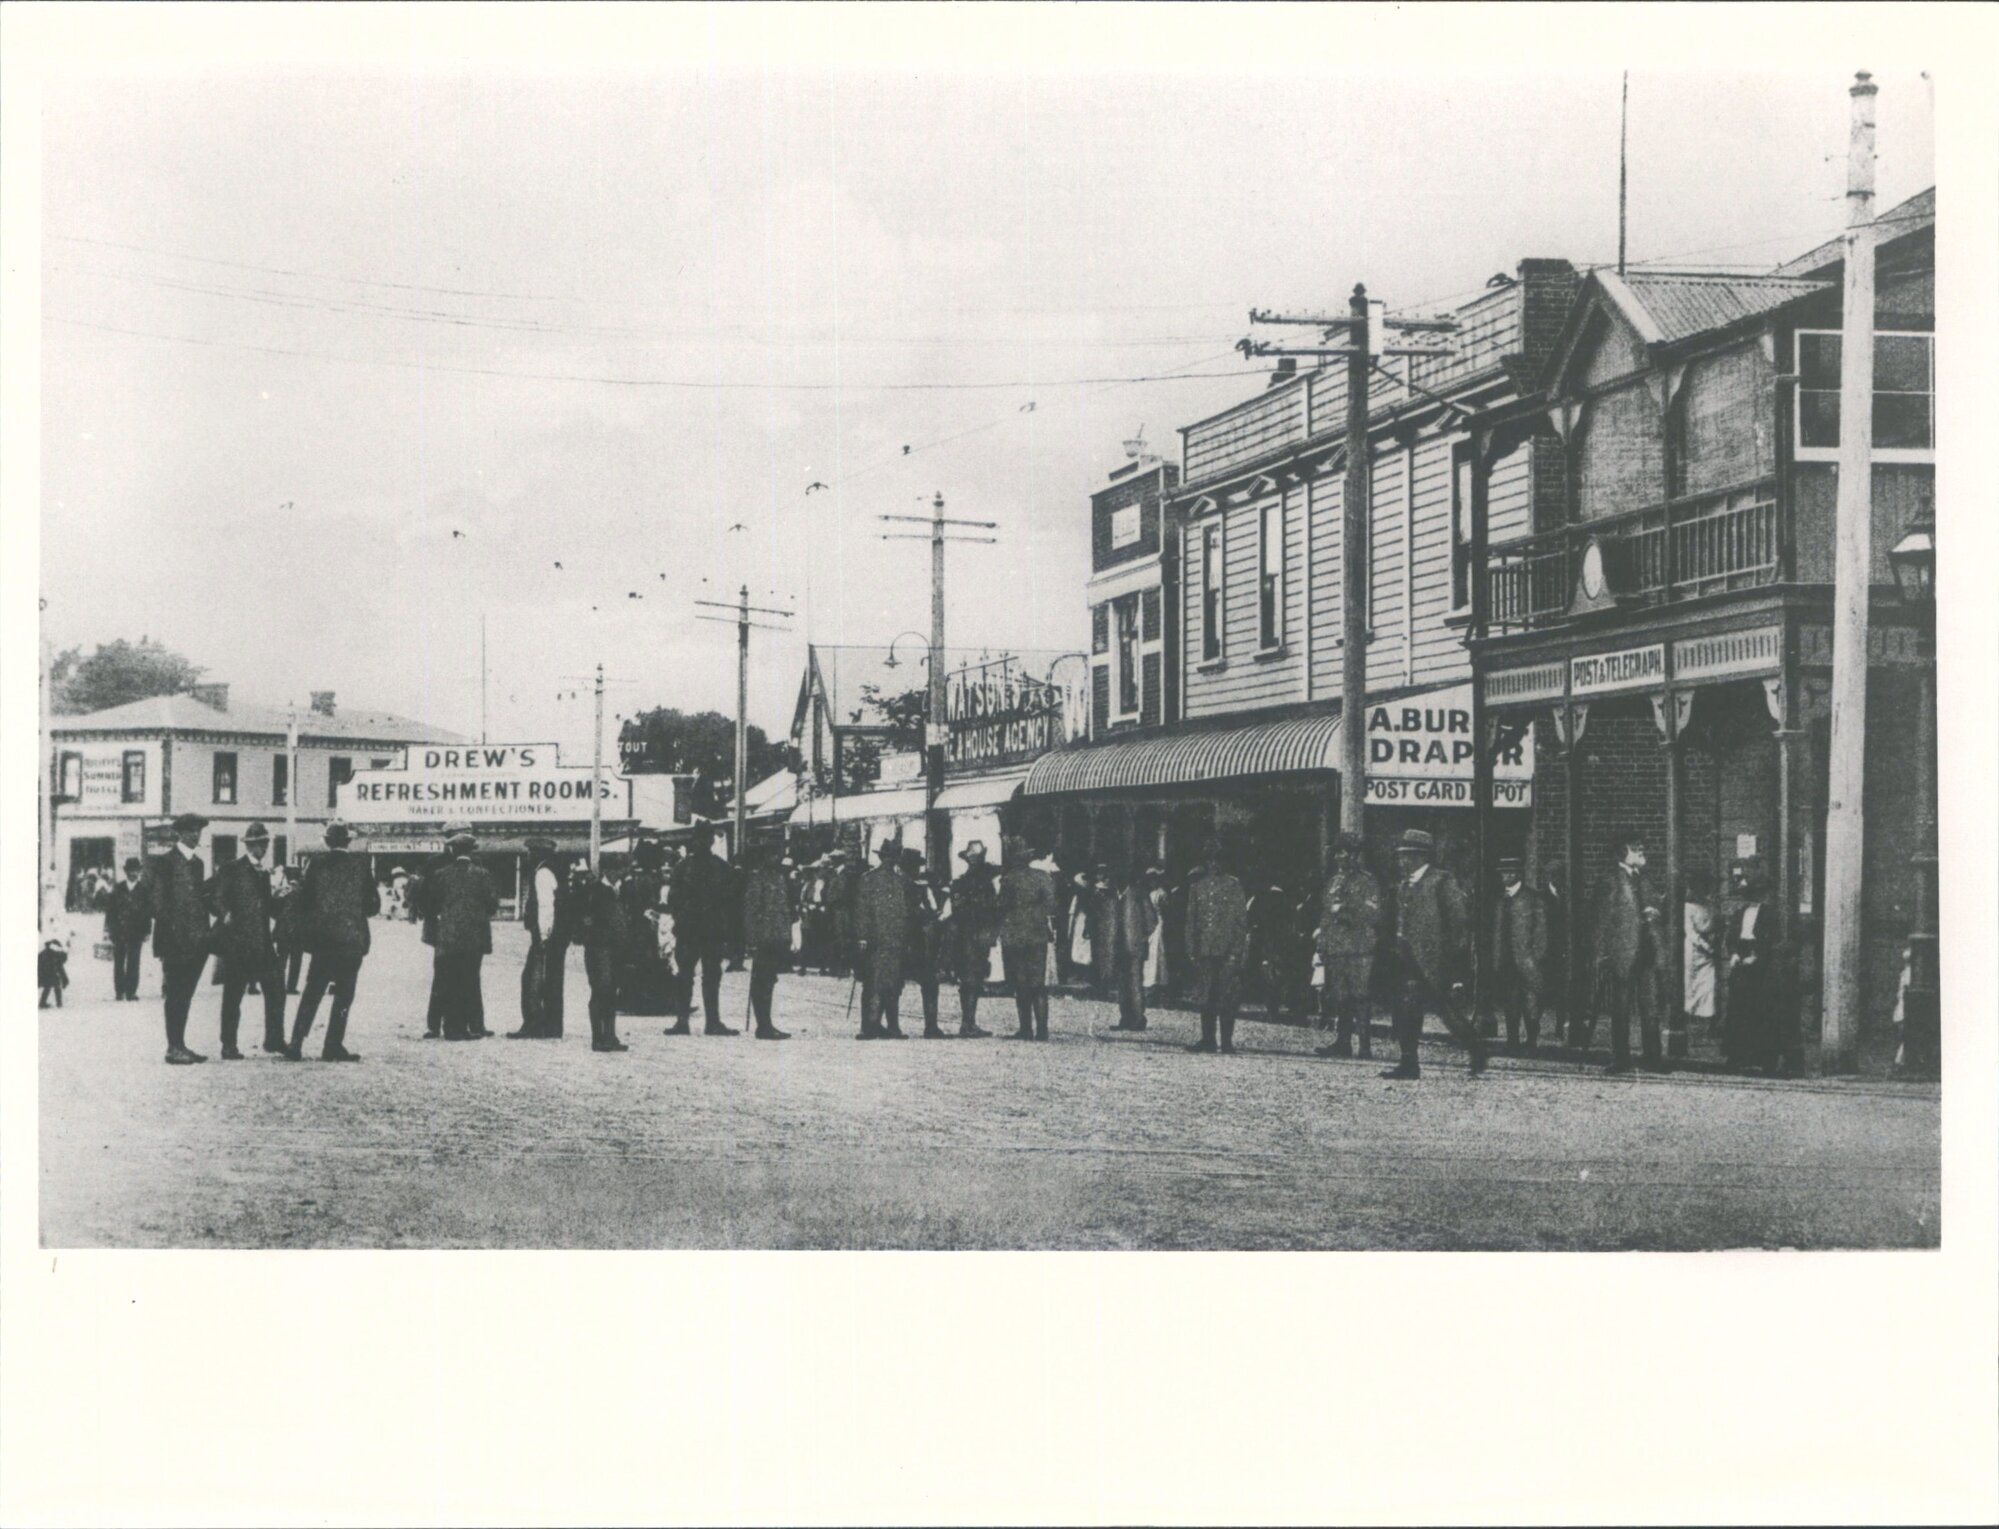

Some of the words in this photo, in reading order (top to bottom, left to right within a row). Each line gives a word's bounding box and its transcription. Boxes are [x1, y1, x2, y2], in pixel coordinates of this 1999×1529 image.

[1573, 658, 1599, 687] POST
[1368, 707, 1470, 733] A.BUR
[965, 724, 1001, 759] HOUSE
[1004, 715, 1050, 753] AGENCY
[425, 747, 536, 768] DREW'S
[1371, 738, 1524, 767] DRAPR
[357, 781, 521, 801] REFRESHMENT
[529, 779, 618, 800] ROOMS.
[1365, 780, 1410, 799] POST
[1470, 784, 1526, 804] POT
